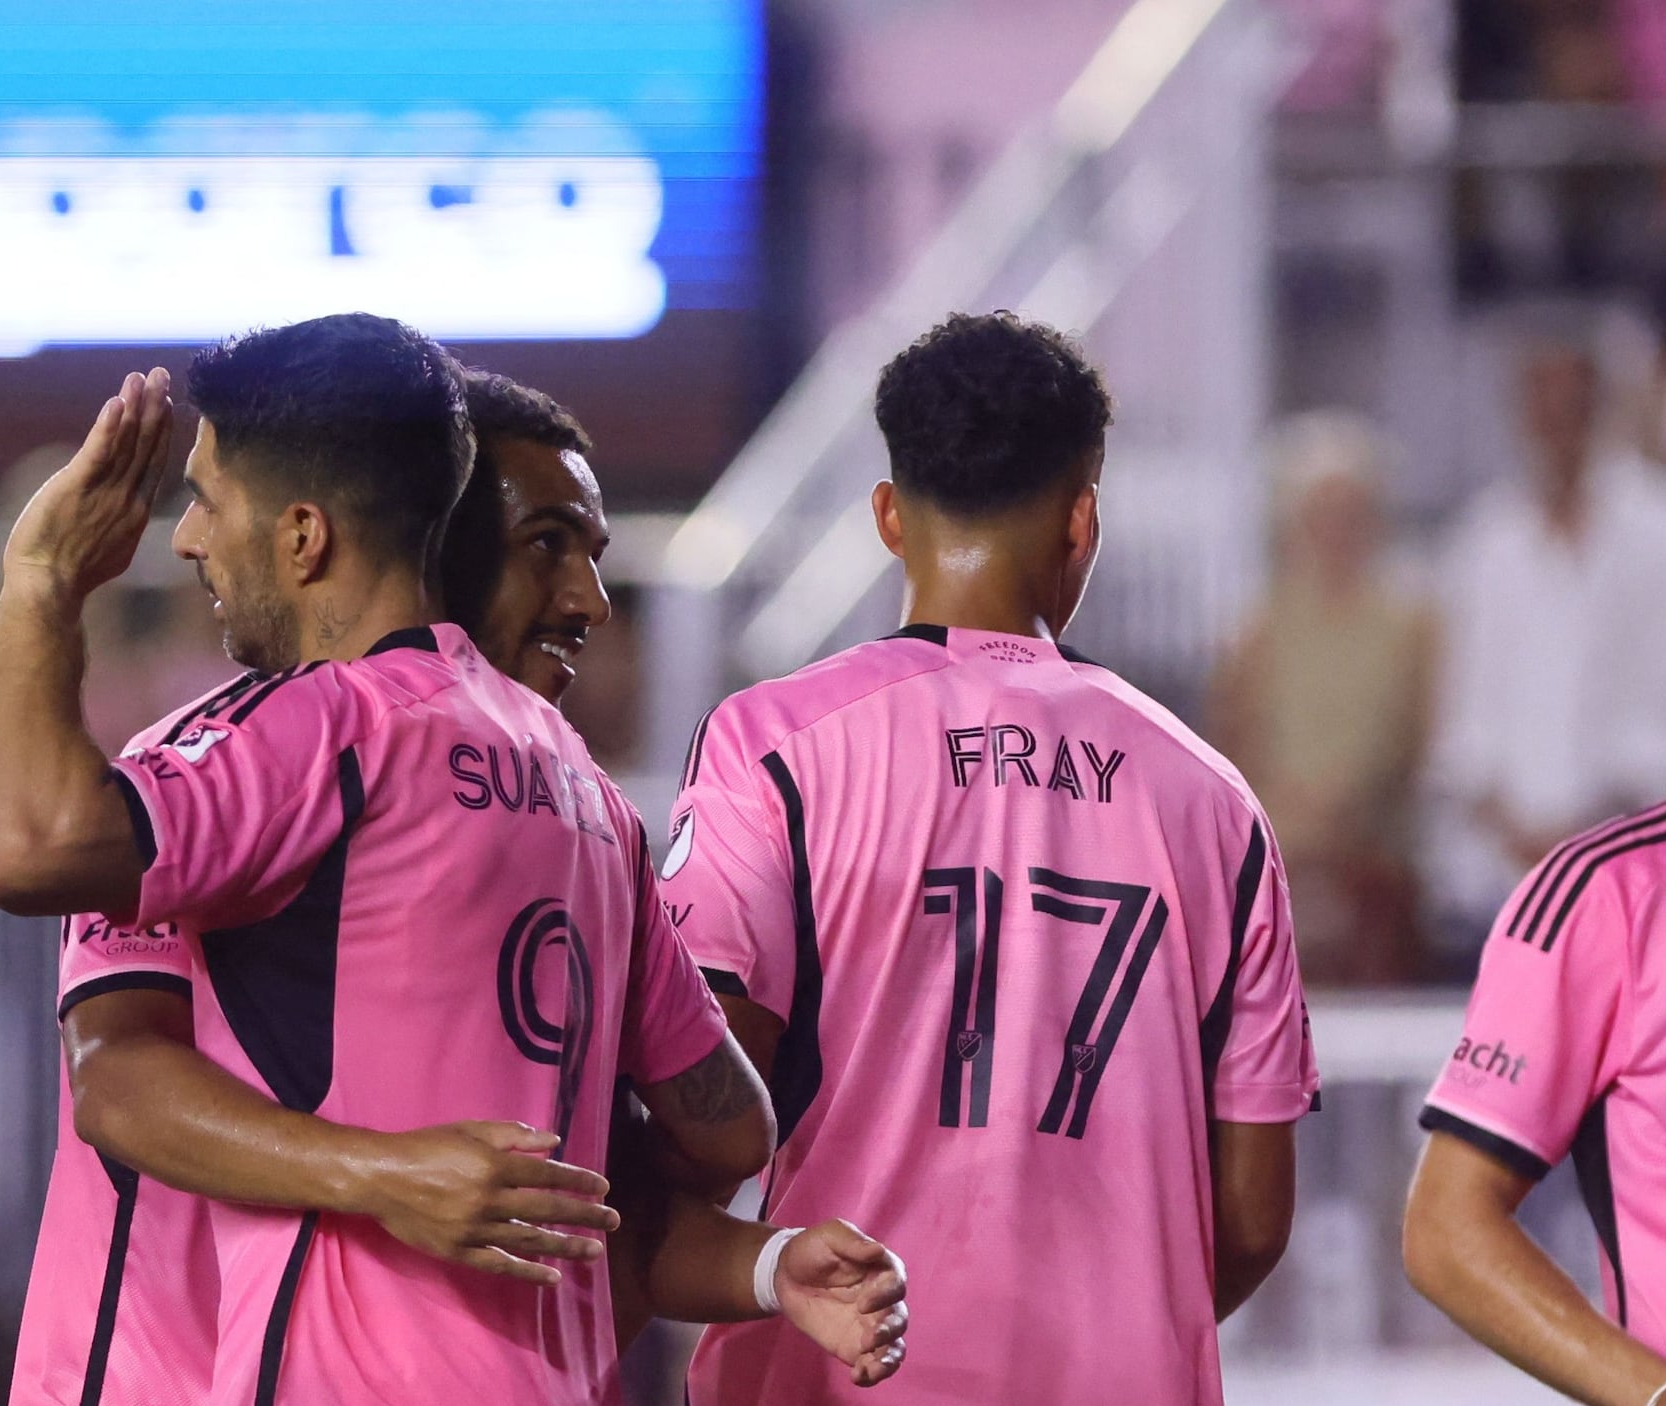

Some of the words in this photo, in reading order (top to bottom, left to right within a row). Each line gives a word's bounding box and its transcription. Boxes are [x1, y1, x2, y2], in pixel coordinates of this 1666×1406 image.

[945, 724, 1127, 804] FRAY
[495, 897, 594, 1163] 9
[924, 866, 1169, 1140] 17
[1453, 1037, 1529, 1086] acht
